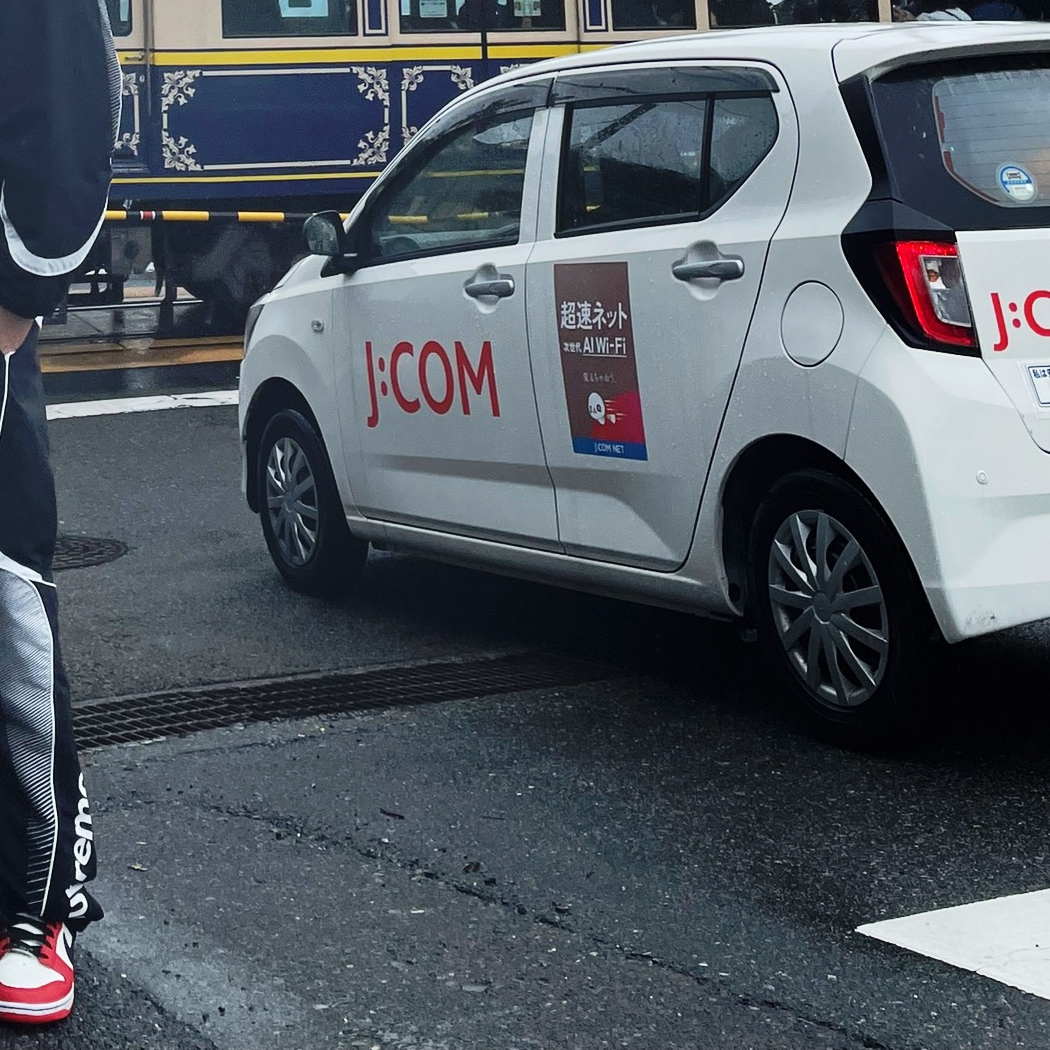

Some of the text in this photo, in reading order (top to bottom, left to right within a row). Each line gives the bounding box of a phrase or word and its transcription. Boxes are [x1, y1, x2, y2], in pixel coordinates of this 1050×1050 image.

[560, 300, 628, 330] 超速ネット
[595, 336, 627, 355] Wi-Fi
[365, 340, 501, 428] J:COM
